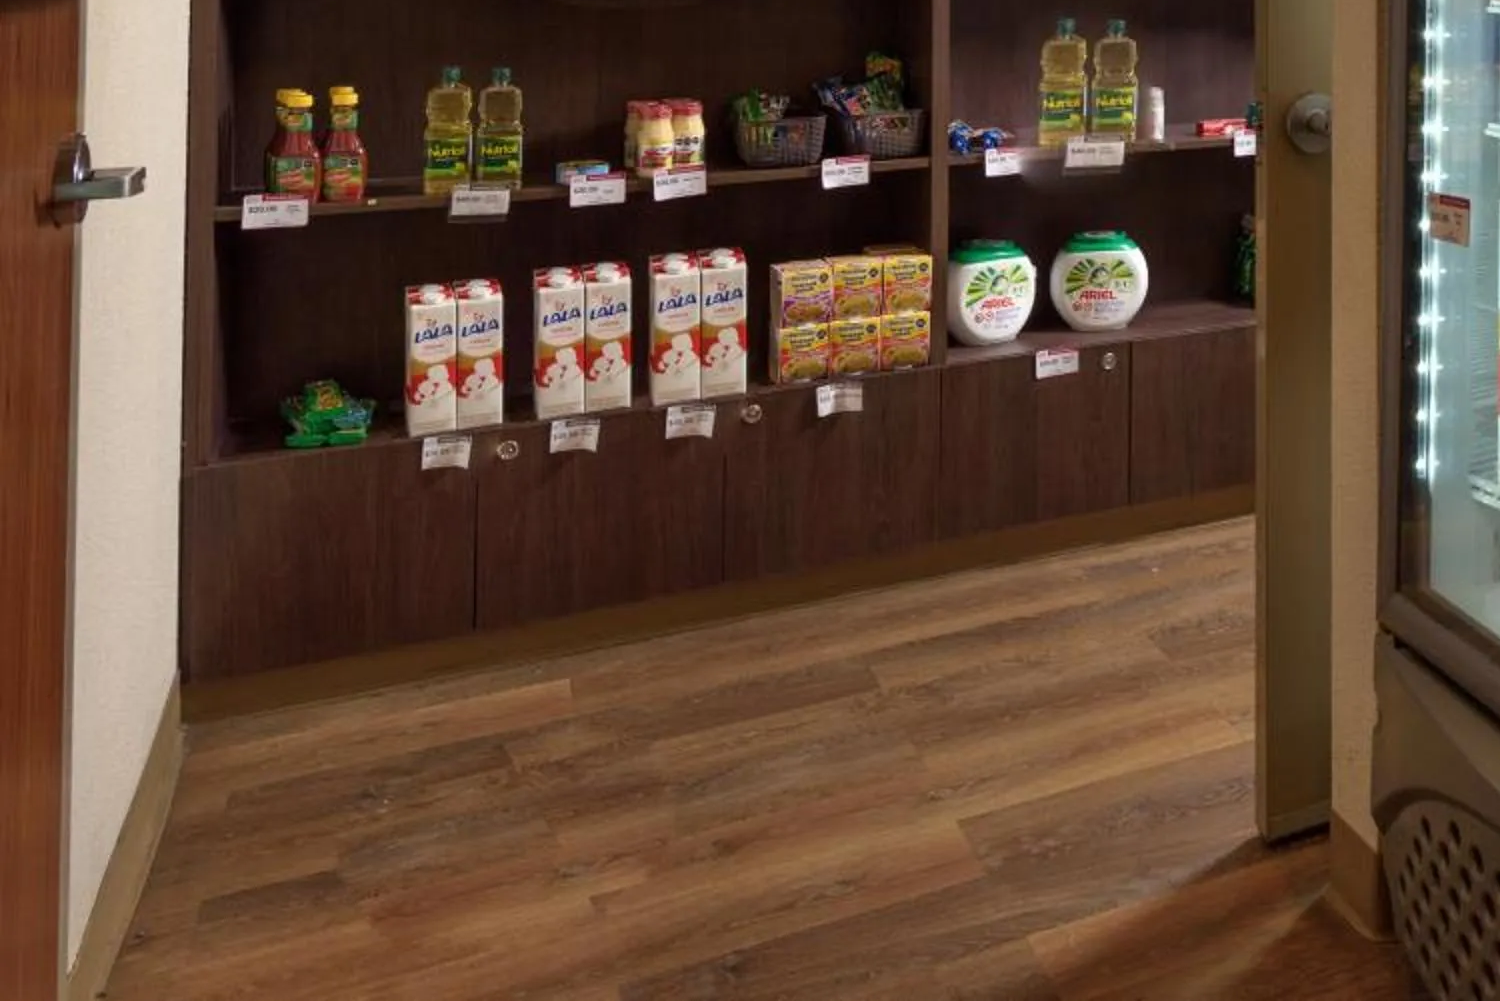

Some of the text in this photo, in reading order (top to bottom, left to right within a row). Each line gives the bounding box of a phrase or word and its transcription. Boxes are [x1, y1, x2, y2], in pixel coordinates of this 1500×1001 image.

[658, 294, 697, 312] LALA
[705, 287, 743, 307] LALA
[1079, 287, 1117, 300] ARIEL
[542, 306, 583, 327] LALA
[589, 302, 628, 321] LALA
[413, 324, 454, 344] LALA
[461, 318, 499, 338] LALA
